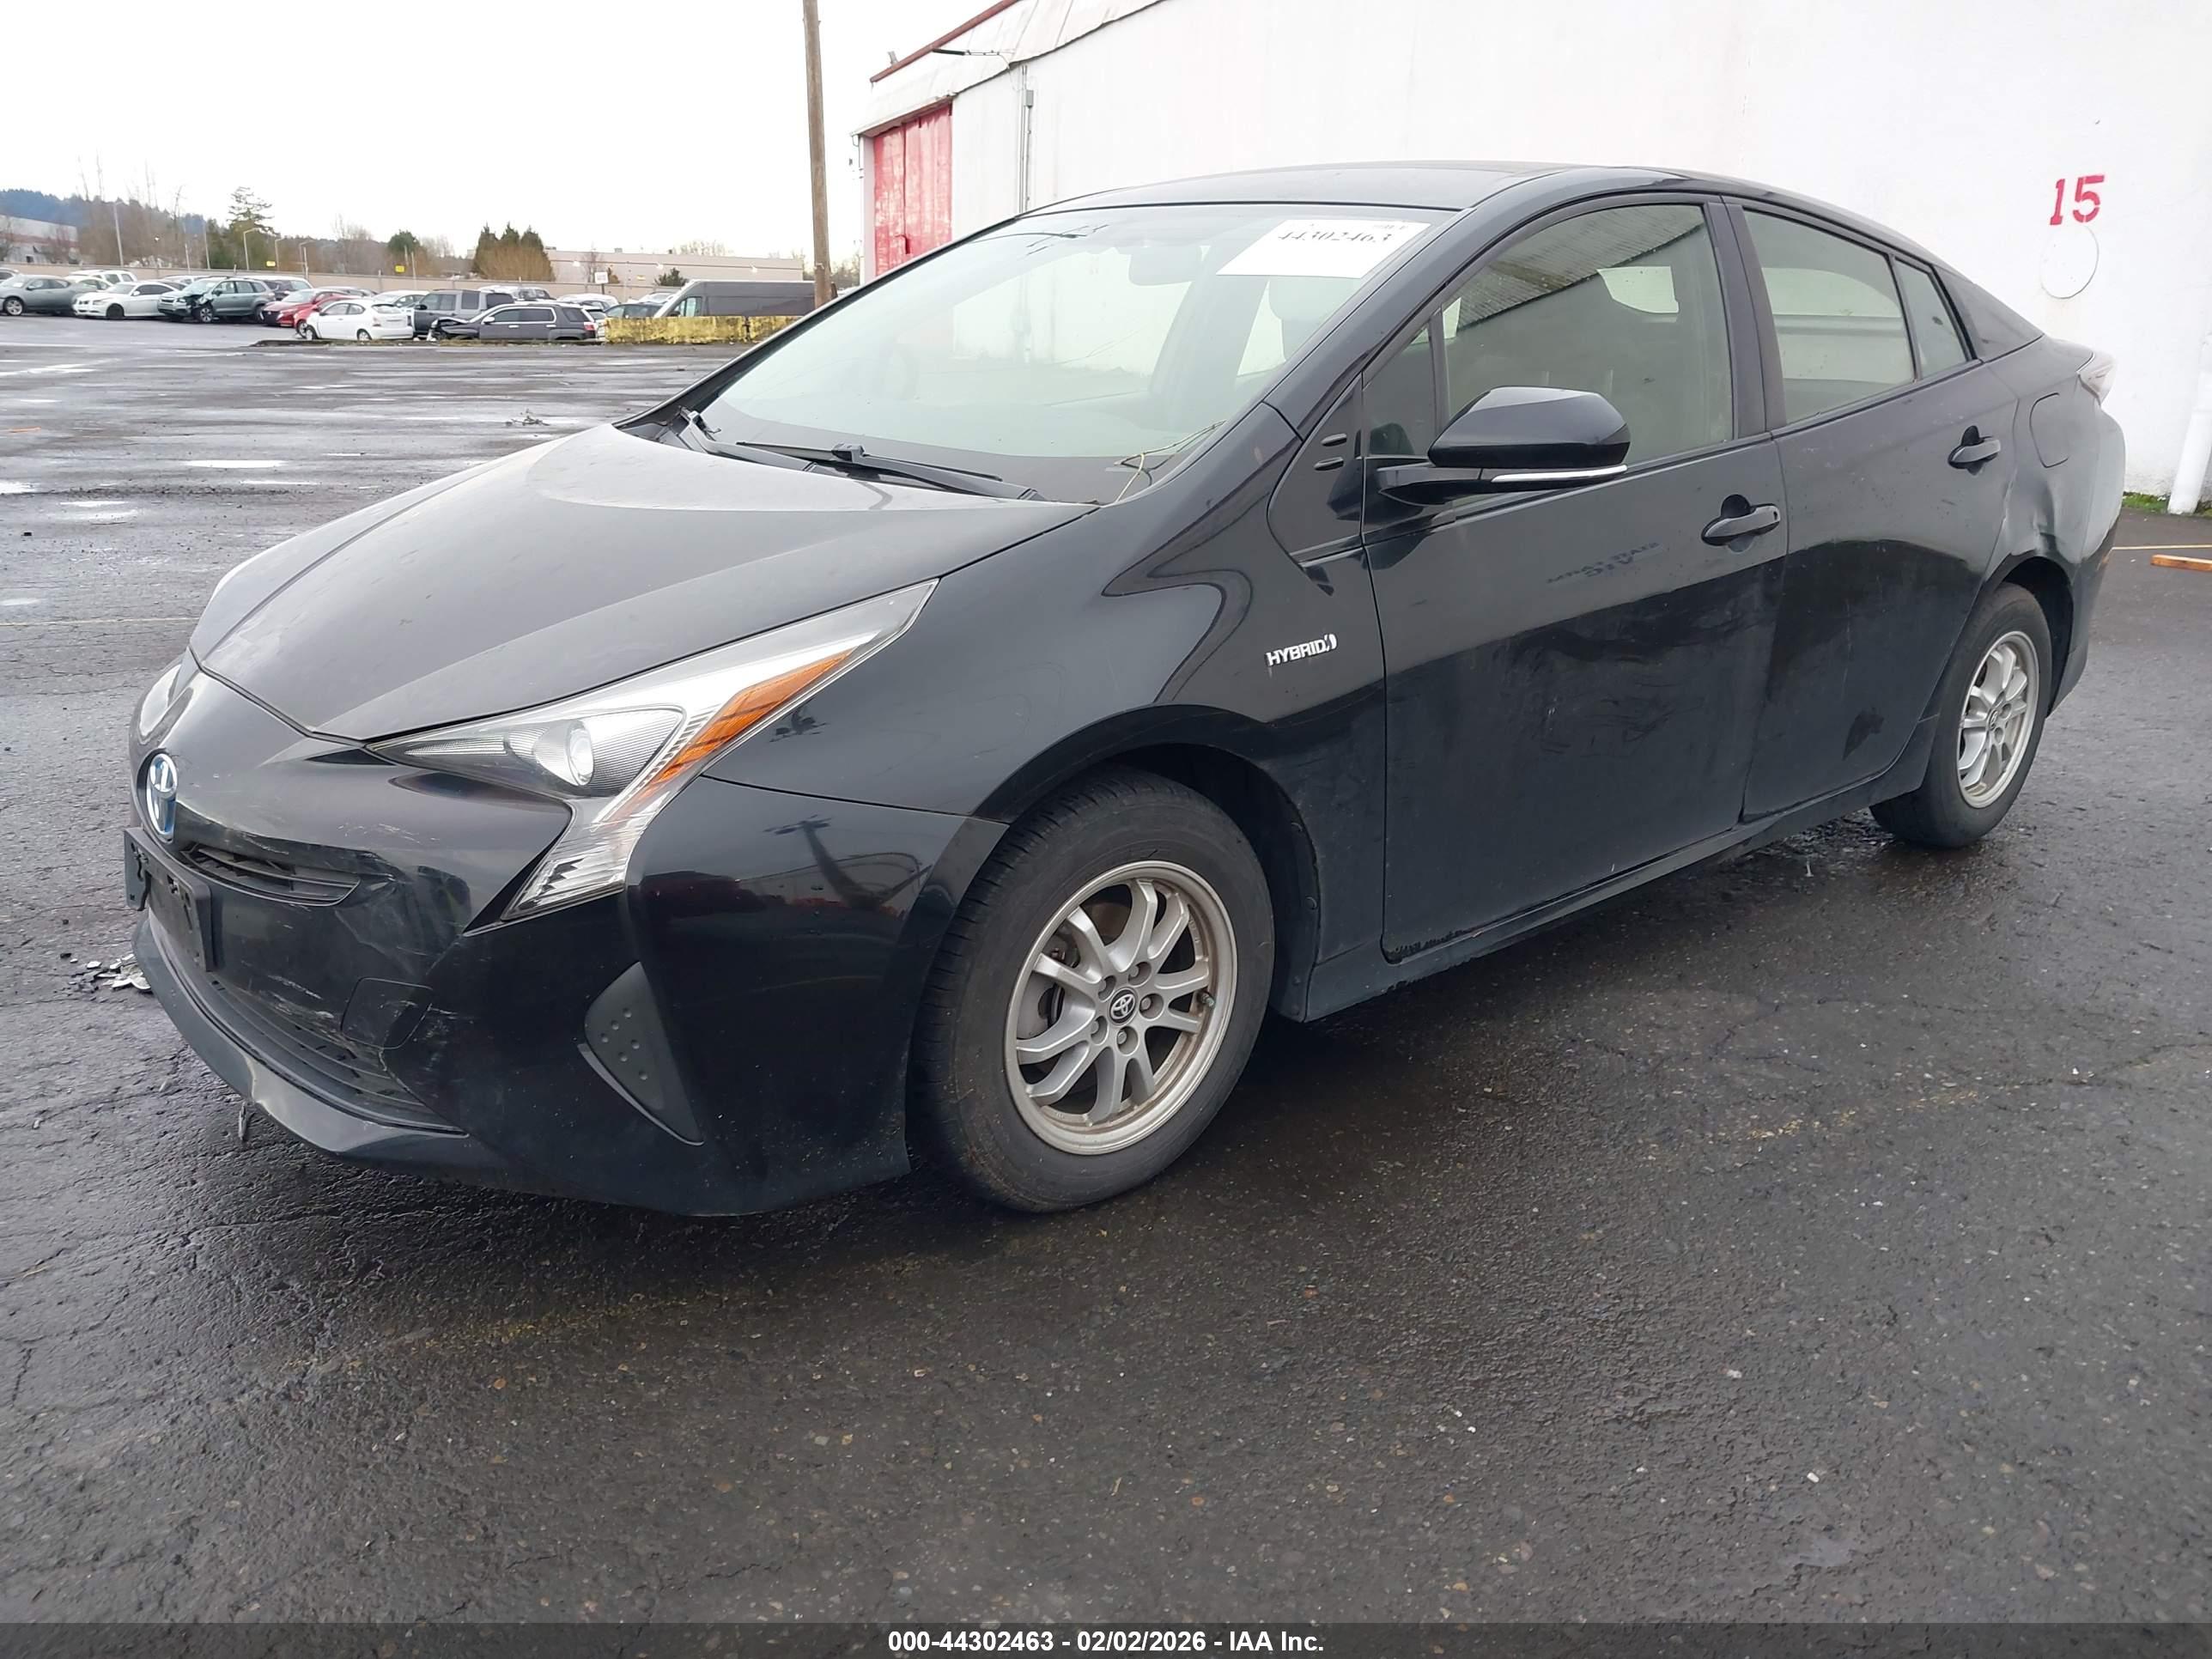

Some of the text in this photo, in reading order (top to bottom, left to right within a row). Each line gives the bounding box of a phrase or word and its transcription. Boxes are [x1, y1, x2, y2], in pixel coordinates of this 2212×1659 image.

[2050, 174, 2104, 227] 15
[1277, 229, 1394, 243] 44302463
[1266, 639, 1327, 666] HYBRID
